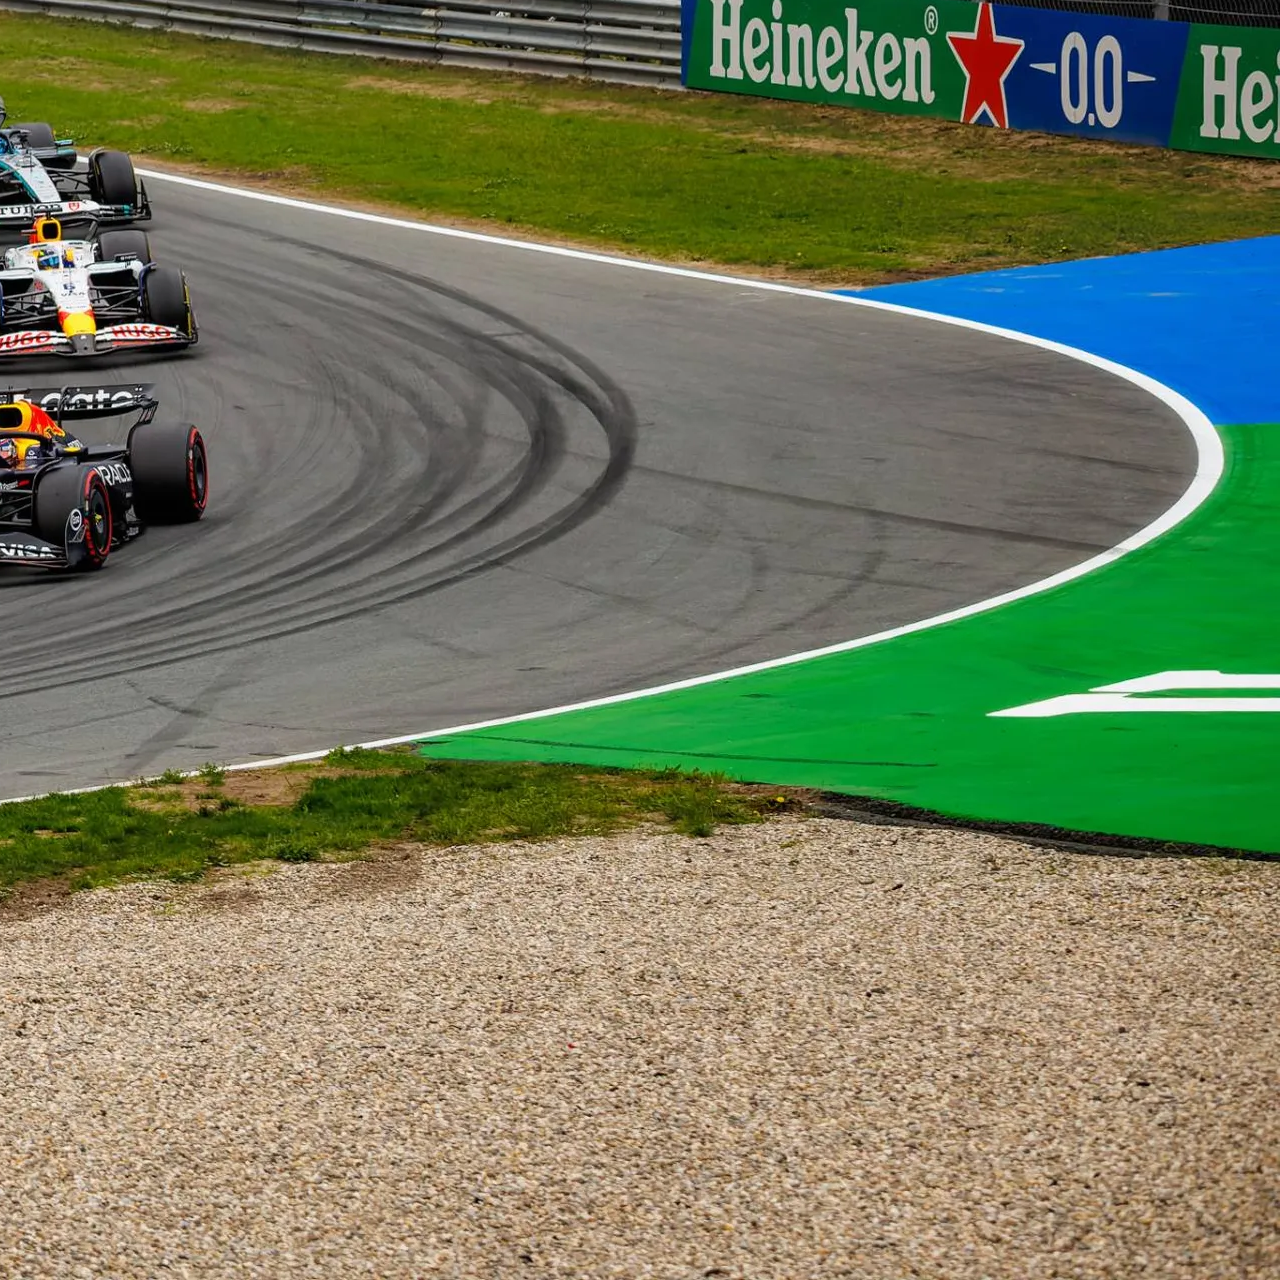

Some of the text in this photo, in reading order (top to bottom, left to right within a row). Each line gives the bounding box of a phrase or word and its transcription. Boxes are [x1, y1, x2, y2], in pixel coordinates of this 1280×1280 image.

[1059, 30, 1124, 129] 0.0
[111, 324, 172, 338] HUGO
[0, 541, 56, 558] VISA
